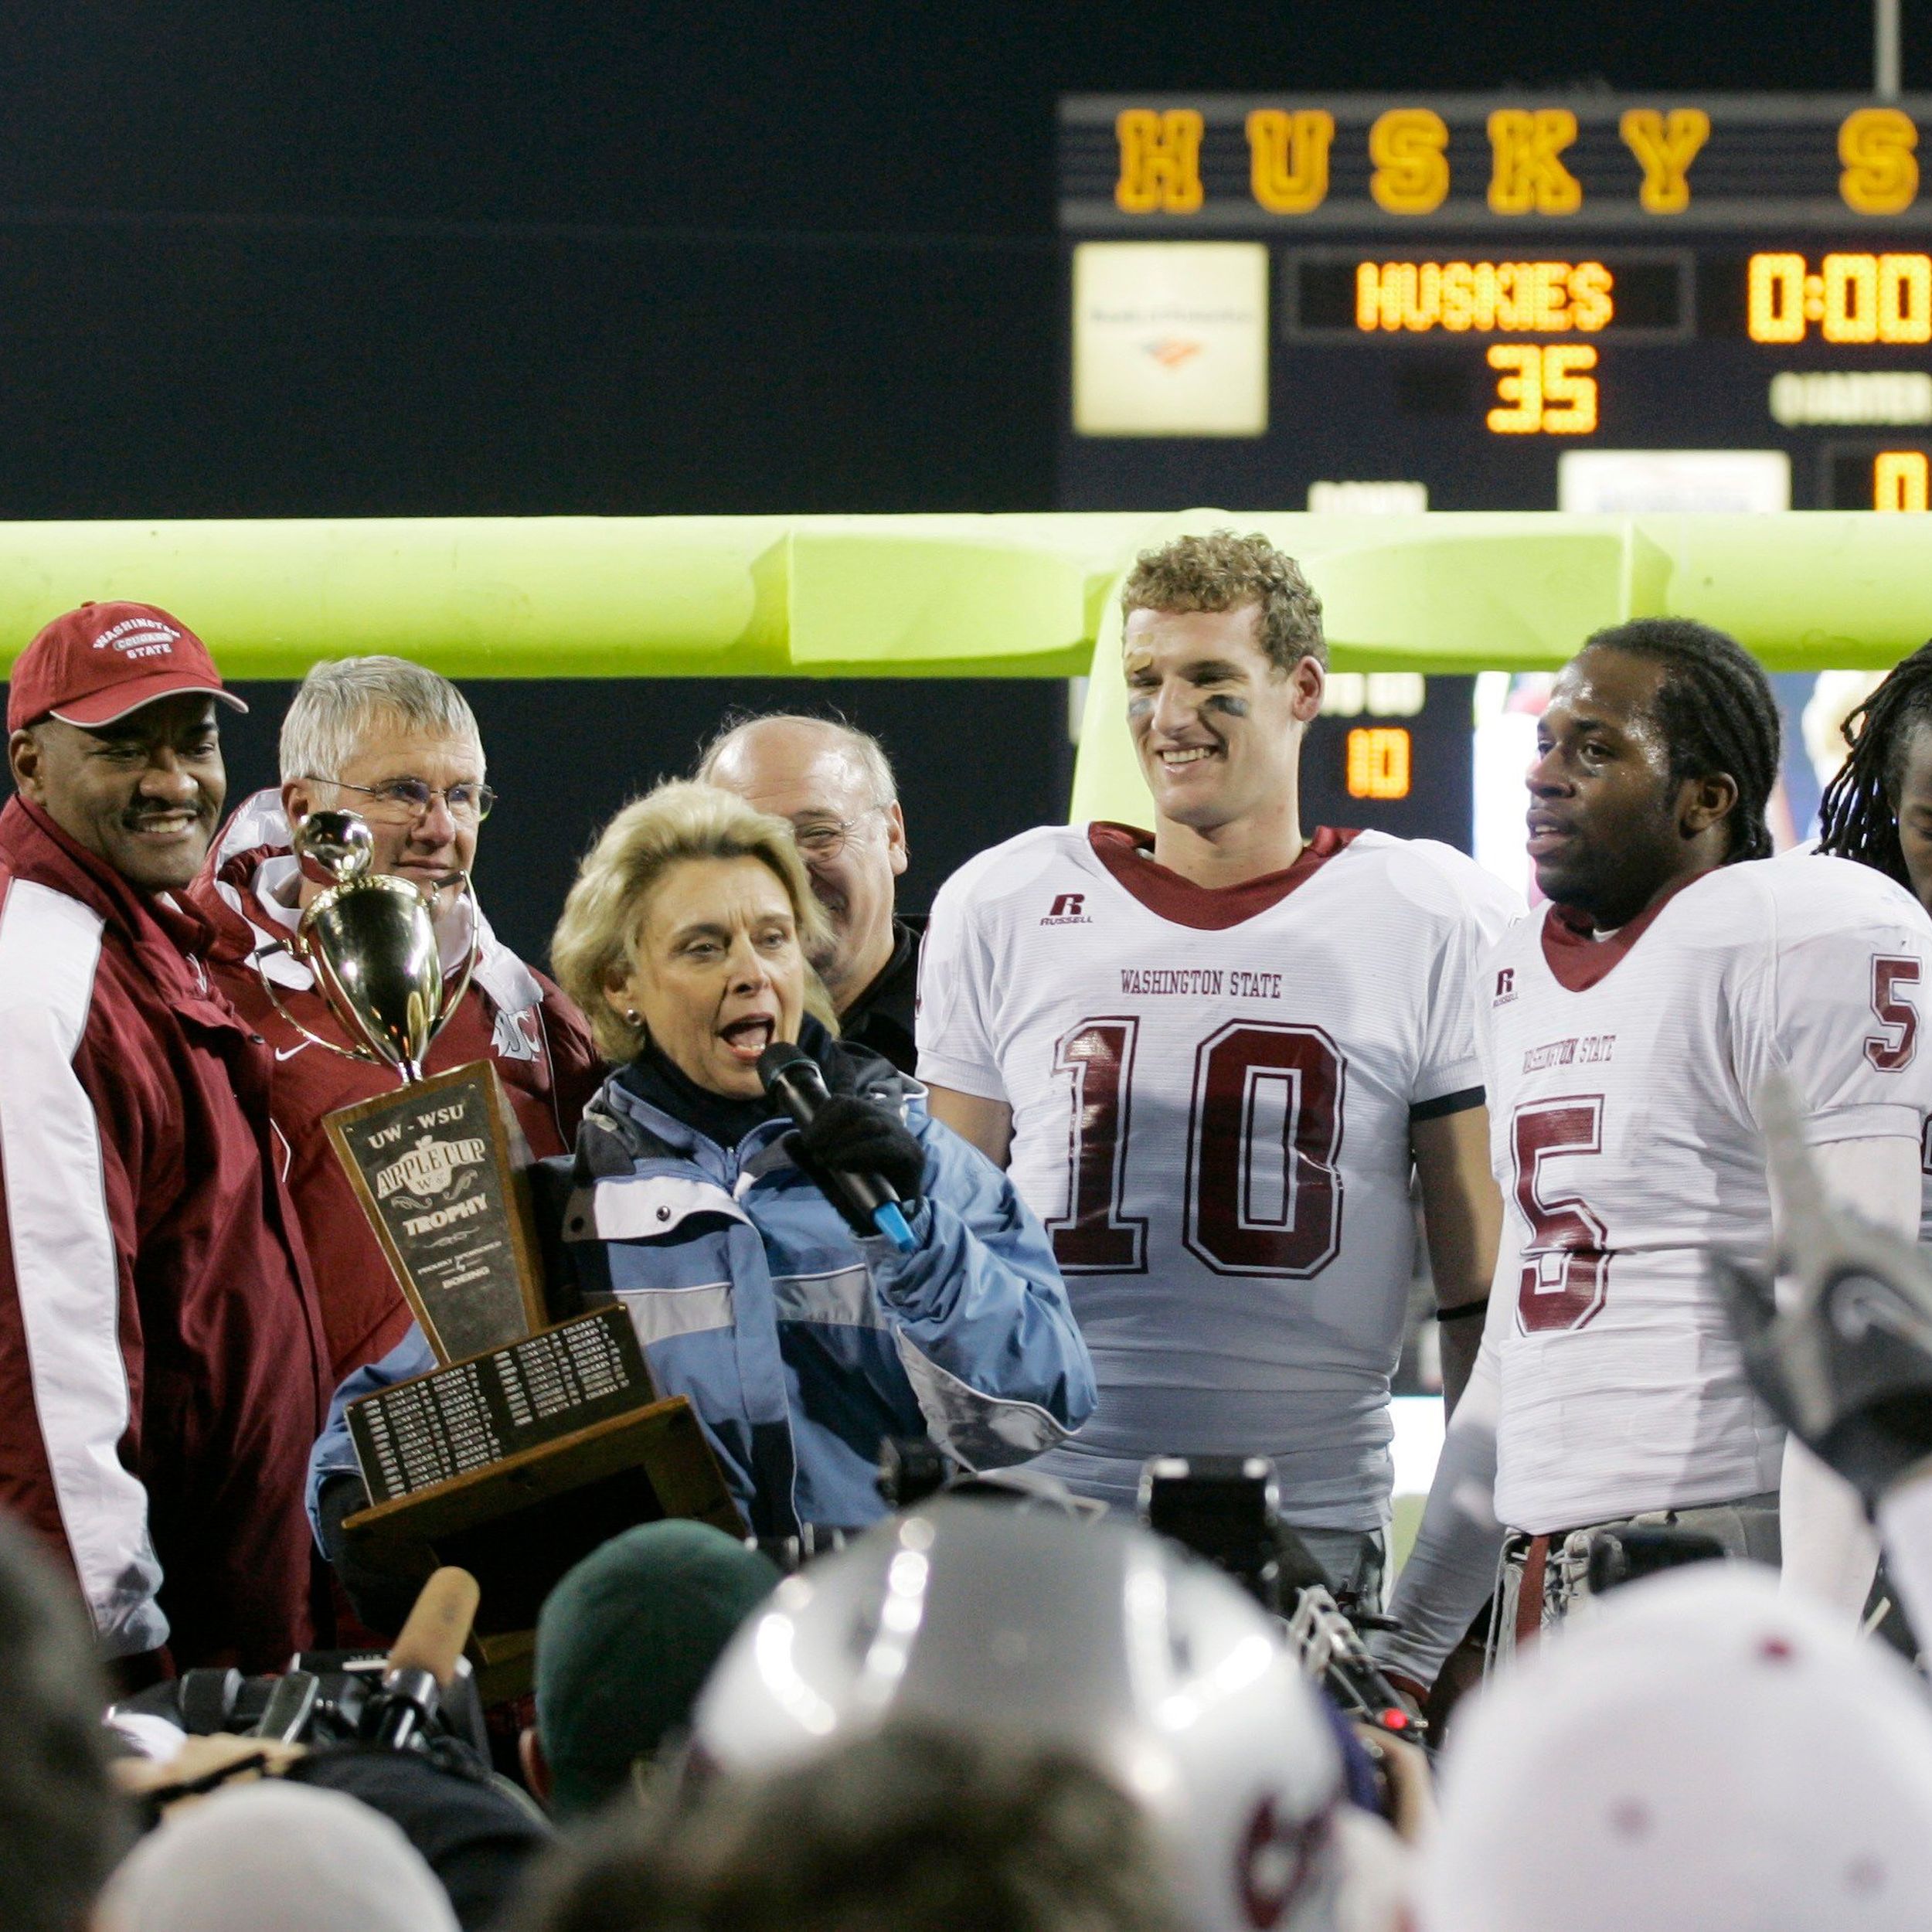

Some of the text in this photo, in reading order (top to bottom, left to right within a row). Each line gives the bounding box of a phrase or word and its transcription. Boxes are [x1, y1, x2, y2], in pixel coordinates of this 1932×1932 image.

[1114, 109, 1710, 215] HUSKY
[1356, 261, 1614, 332] HUSKIES
[1748, 253, 1932, 343] 0:00
[1486, 344, 1598, 434] 35
[126, 643, 172, 659] STATE
[1347, 727, 1410, 798] 10
[1039, 916, 1094, 926] RUSSELL
[1121, 969, 1282, 998] WASHINGTON STATE
[1863, 953, 1922, 1073] 5
[368, 1124, 402, 1149] UW
[417, 1104, 464, 1129] WSU
[1045, 1015, 1348, 1281] 10
[377, 1138, 486, 1197] APPLE CUP
[402, 1192, 488, 1236] TROPHY
[1510, 1094, 1611, 1338] 5
